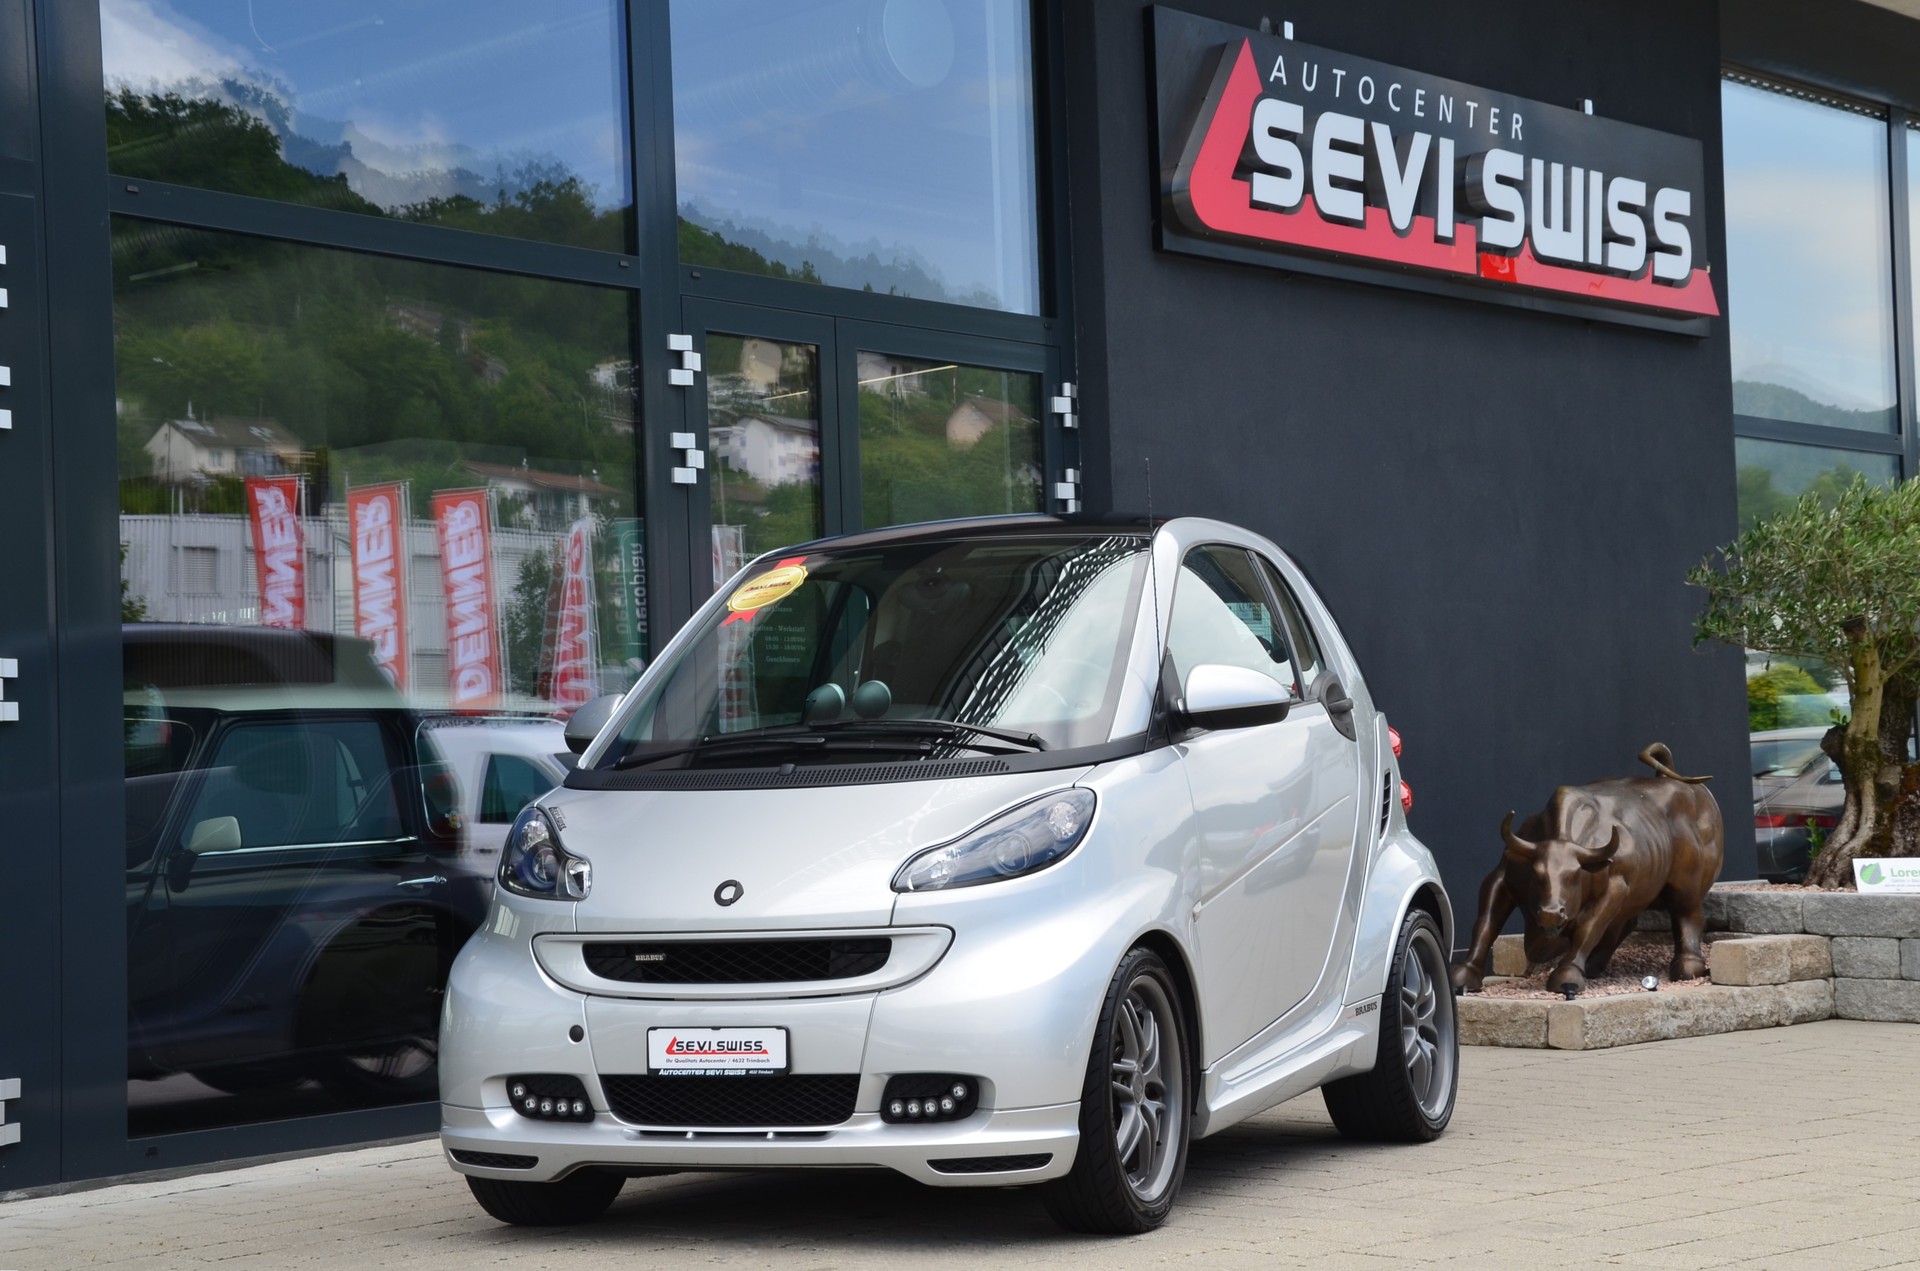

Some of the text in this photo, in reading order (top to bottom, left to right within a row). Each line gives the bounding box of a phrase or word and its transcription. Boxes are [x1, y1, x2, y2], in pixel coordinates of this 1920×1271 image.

[1269, 54, 1524, 141] AUTOCENTER
[1252, 97, 1692, 280] SEVI SWISS
[1355, 1001, 1378, 1016] BRABUS
[675, 1040, 763, 1052] SEVI SWISS
